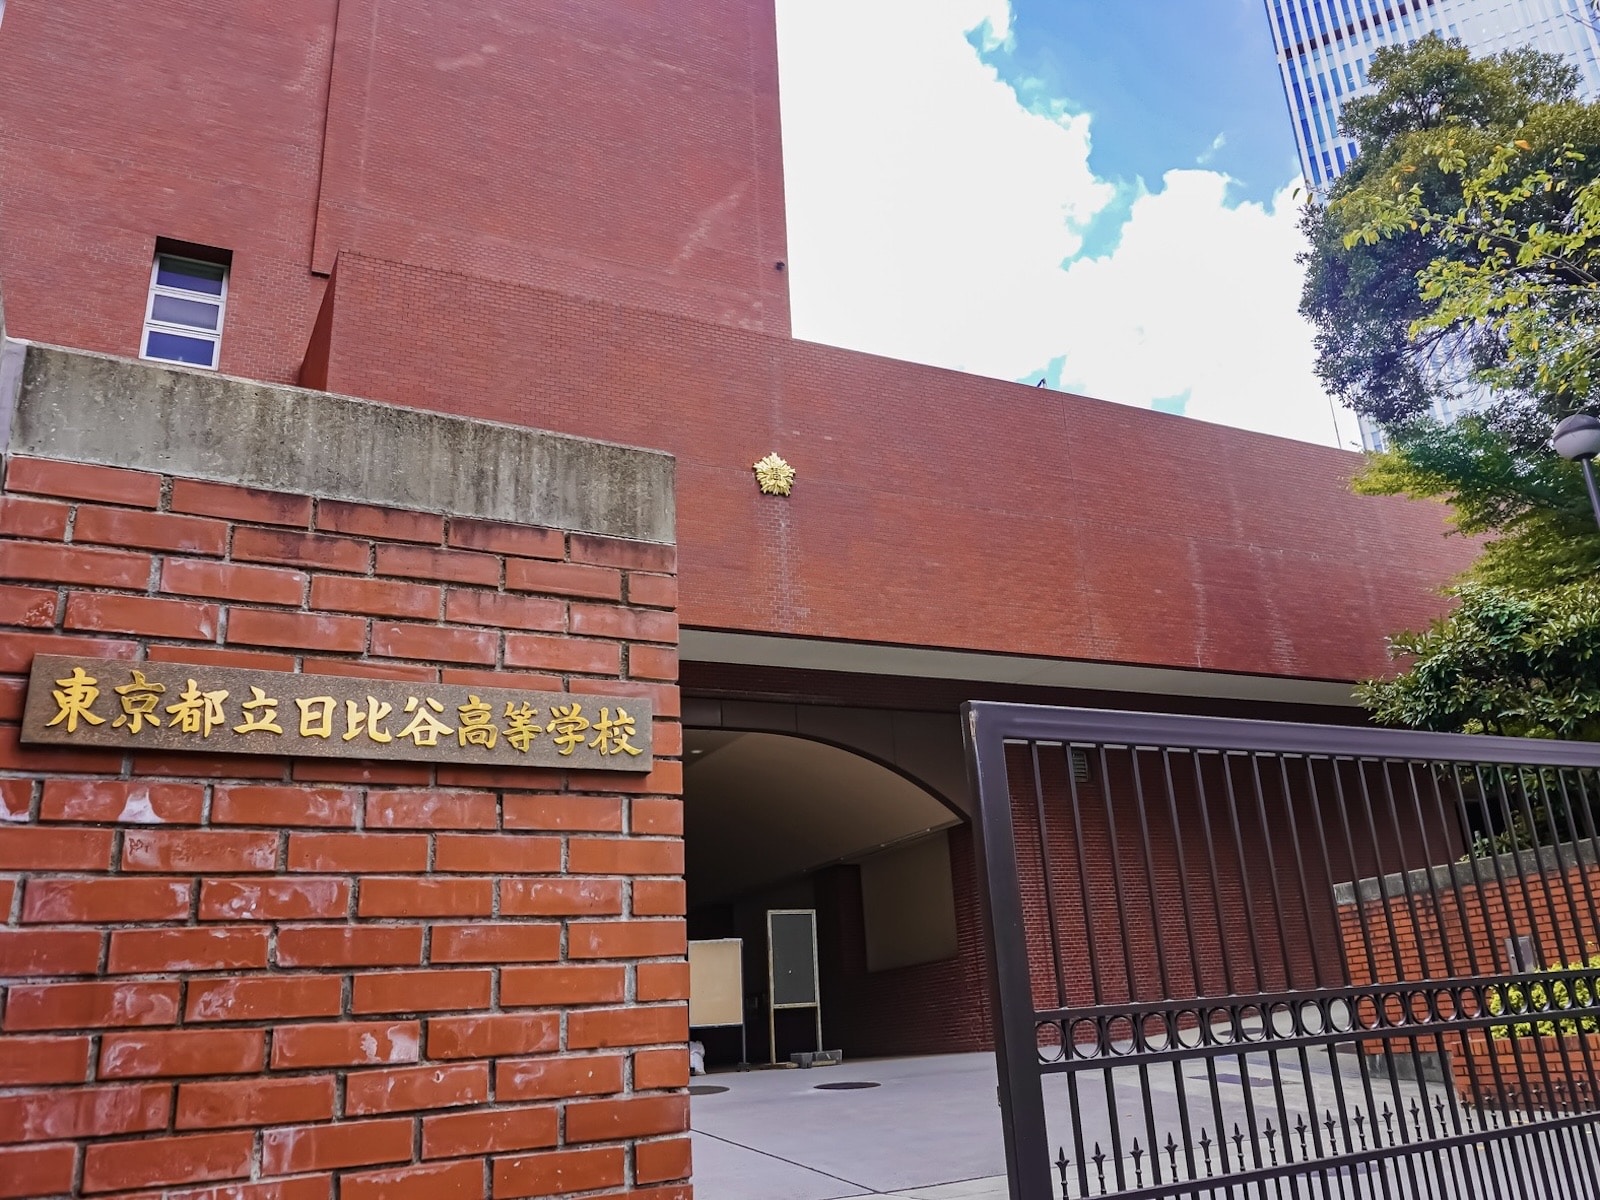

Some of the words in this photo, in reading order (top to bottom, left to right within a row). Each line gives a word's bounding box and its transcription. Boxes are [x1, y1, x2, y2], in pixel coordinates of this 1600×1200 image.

[47, 667, 643, 757] 東京都立日比谷高等学校
